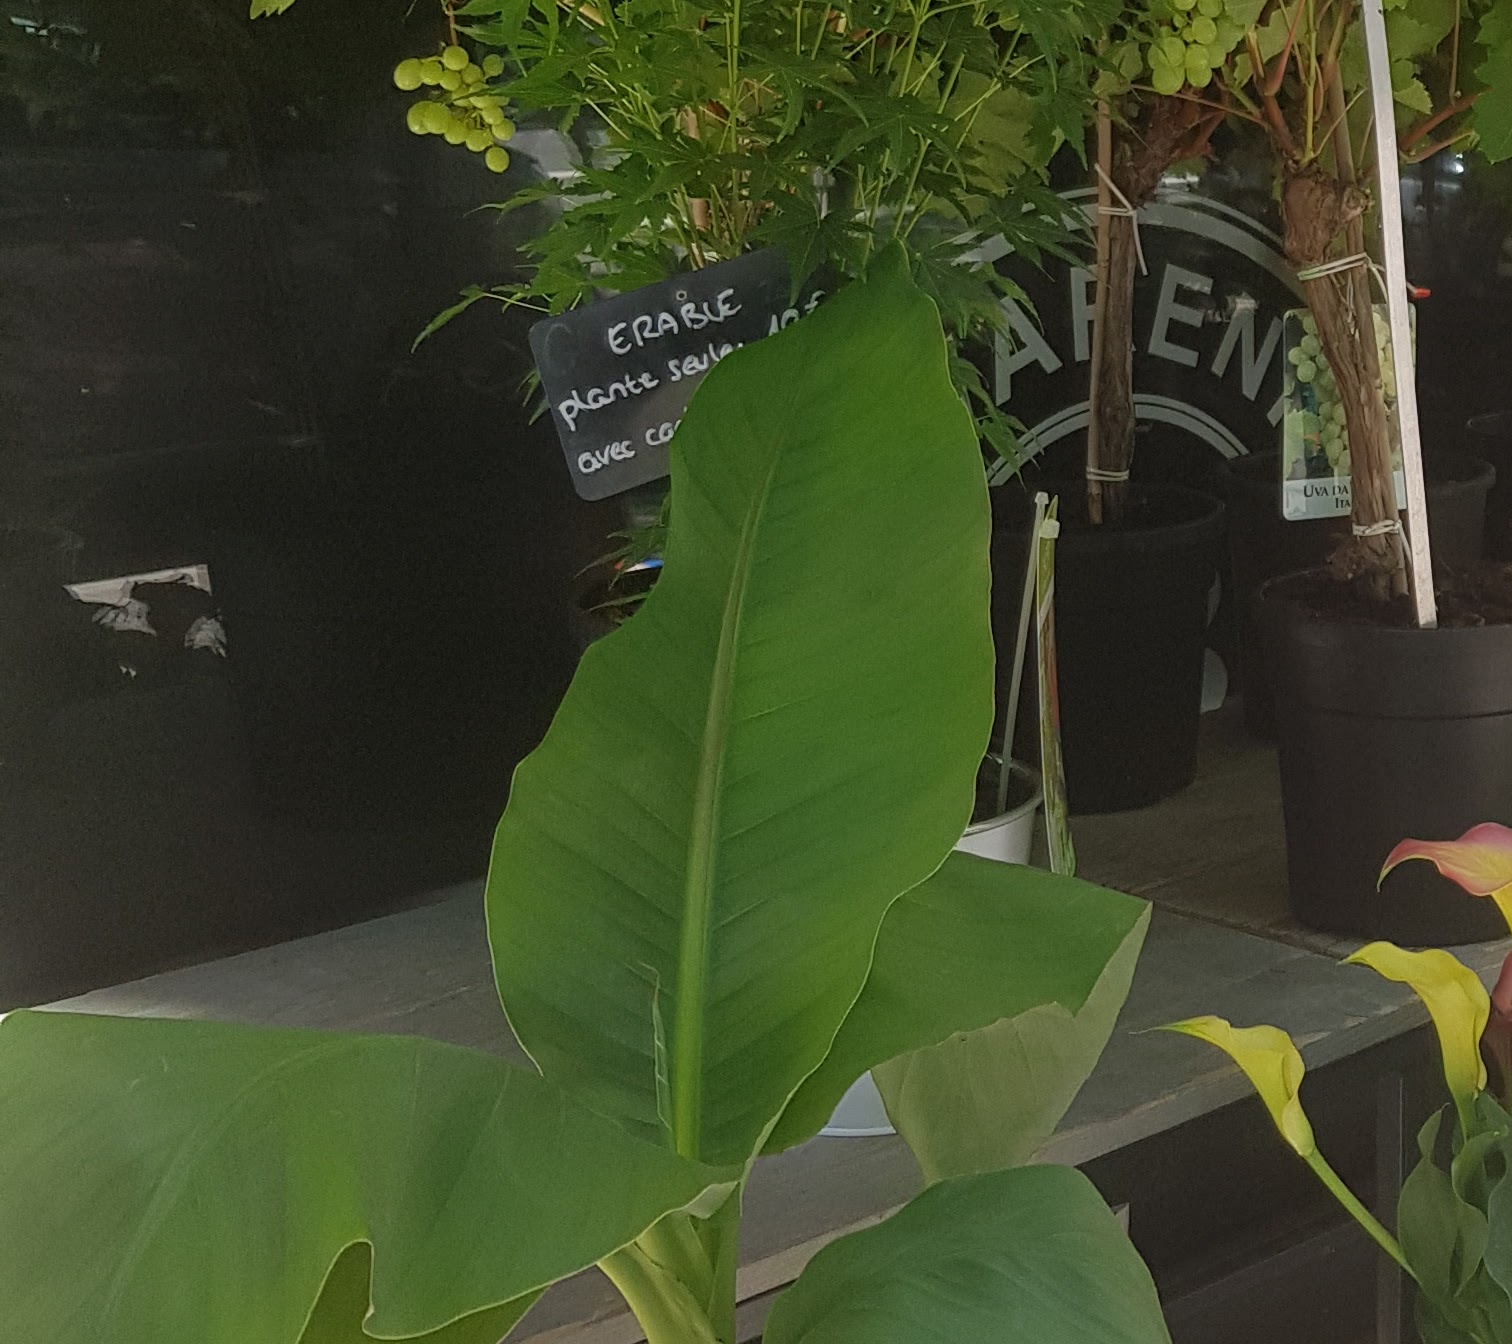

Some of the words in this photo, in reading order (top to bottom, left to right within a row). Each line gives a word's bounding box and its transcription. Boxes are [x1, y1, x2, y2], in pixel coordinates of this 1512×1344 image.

[607, 287, 743, 356] ERABLE
[558, 372, 660, 433] plante
[577, 438, 637, 475] avec
